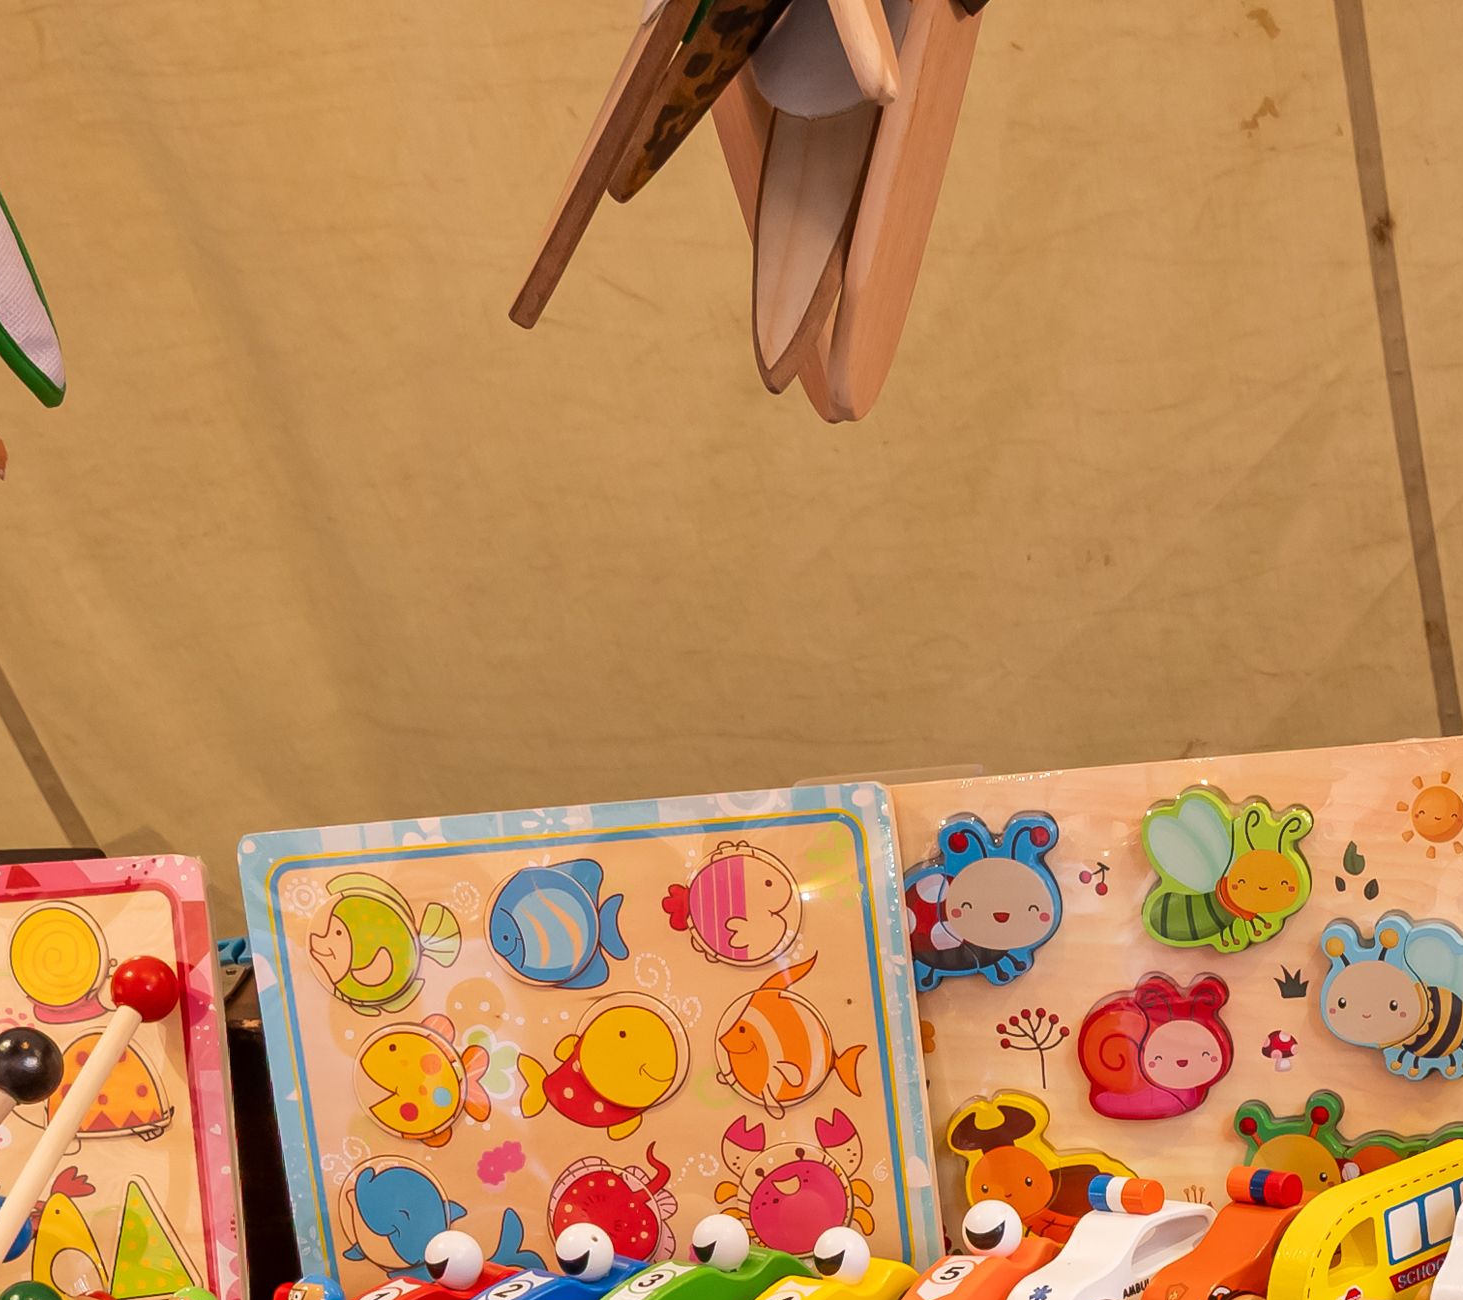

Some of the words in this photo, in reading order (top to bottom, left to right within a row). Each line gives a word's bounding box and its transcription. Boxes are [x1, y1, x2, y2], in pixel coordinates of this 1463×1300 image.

[939, 1265, 966, 1281] 5
[636, 1273, 666, 1291] 3
[492, 1283, 524, 1300] 2
